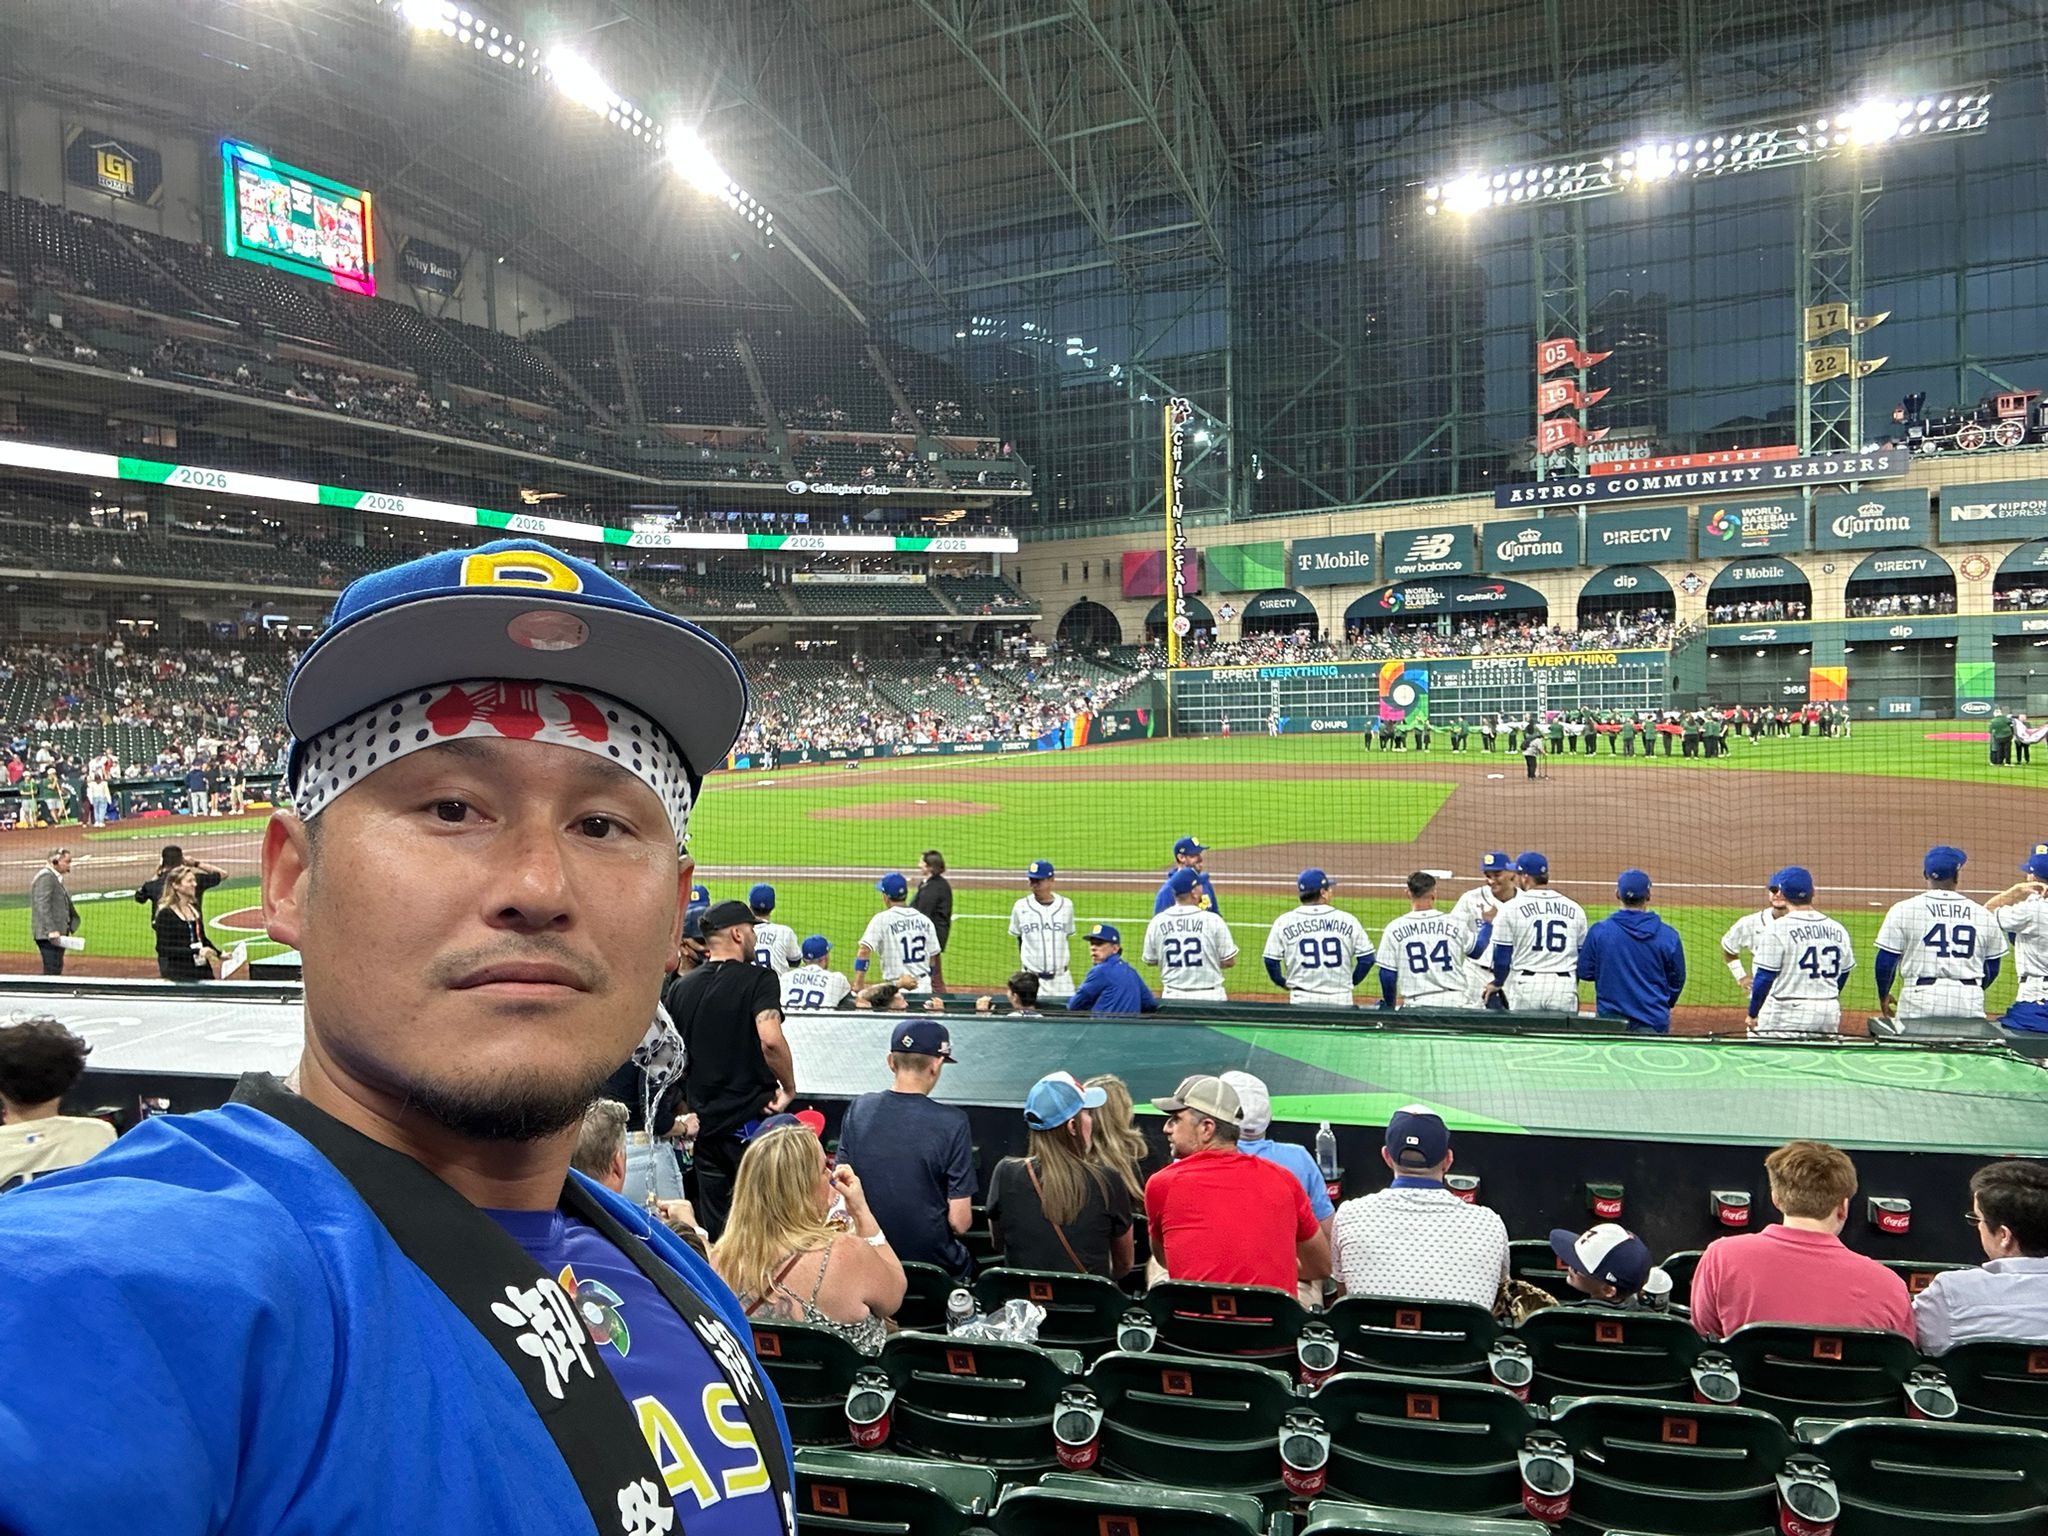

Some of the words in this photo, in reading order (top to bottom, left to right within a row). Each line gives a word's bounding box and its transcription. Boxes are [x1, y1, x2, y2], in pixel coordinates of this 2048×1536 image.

[97, 149, 134, 185] LGI
[405, 253, 428, 274] Why
[430, 262, 457, 280] Rent?
[1815, 309, 1838, 329] 17
[1545, 344, 1567, 363] 05
[1814, 356, 1837, 374] 22
[1546, 386, 1567, 404] 19
[1546, 425, 1565, 442] 21
[1594, 450, 1647, 462] LIVING
[1614, 457, 1691, 472] DAIKIN
[1708, 451, 1762, 463] PARK
[181, 469, 227, 489] 2026
[1510, 482, 1596, 502] ASTROS
[1607, 467, 1762, 493] COMMUNITY
[1773, 456, 1889, 479] LEADERS
[810, 483, 862, 496] Gallagher
[863, 484, 891, 495] Club
[368, 495, 405, 512] 2026
[1741, 506, 1782, 518] WORLD
[1999, 500, 2047, 510] NIPPON
[1741, 512, 1798, 525] BASEBALL
[1999, 508, 2047, 518] EXPRESS
[515, 516, 546, 531] 2026
[1741, 521, 1789, 532] CLASSIC
[1832, 515, 1911, 539] Corona
[635, 534, 672, 545] 2026
[791, 537, 825, 548] 2026
[936, 539, 967, 550] 2026
[1603, 527, 1672, 546] DIRECTV
[1496, 539, 1563, 562] Corona
[1315, 550, 1370, 569] Mobile
[1394, 563, 1417, 574] new
[1417, 560, 1463, 573] balance
[1874, 559, 1928, 572] DIRECTV
[1745, 566, 1785, 579] Mobile
[1613, 575, 1638, 589] dip
[1404, 587, 1434, 595] WORLD
[1404, 592, 1446, 600] BASEBALL
[1260, 599, 1297, 609] DIRECTV
[1889, 625, 1913, 638] dip
[1471, 657, 1525, 670] EXPECT
[1527, 654, 1617, 667] EVERYTHING
[1212, 669, 1259, 680] EXPECT
[1260, 665, 1338, 678] EVERYTHING
[1783, 686, 1806, 694] 366
[1889, 703, 1911, 713] IHI
[953, 744, 984, 752] KONAMI
[1002, 742, 1030, 750] DIRECTV
[1519, 901, 1576, 920] ORLANDO
[1926, 903, 1972, 920] VIEIRA
[888, 917, 931, 936] NISHIYAMA
[1159, 921, 1175, 936] DA
[1176, 919, 1204, 933] SILVA
[1281, 917, 1354, 942] OGASSAWARA
[1788, 924, 1843, 945] PARDINHO
[1531, 919, 1568, 952] 16
[1922, 923, 1977, 958] 49
[899, 936, 926, 964] 12
[1164, 937, 1203, 967] 22
[1299, 937, 1343, 969] 99
[1405, 940, 1453, 974] 84
[1799, 945, 1841, 979] 43
[792, 973, 829, 988] GOMES
[1501, 1041, 1963, 1083] 2026
[632, 1381, 771, 1509] AS
